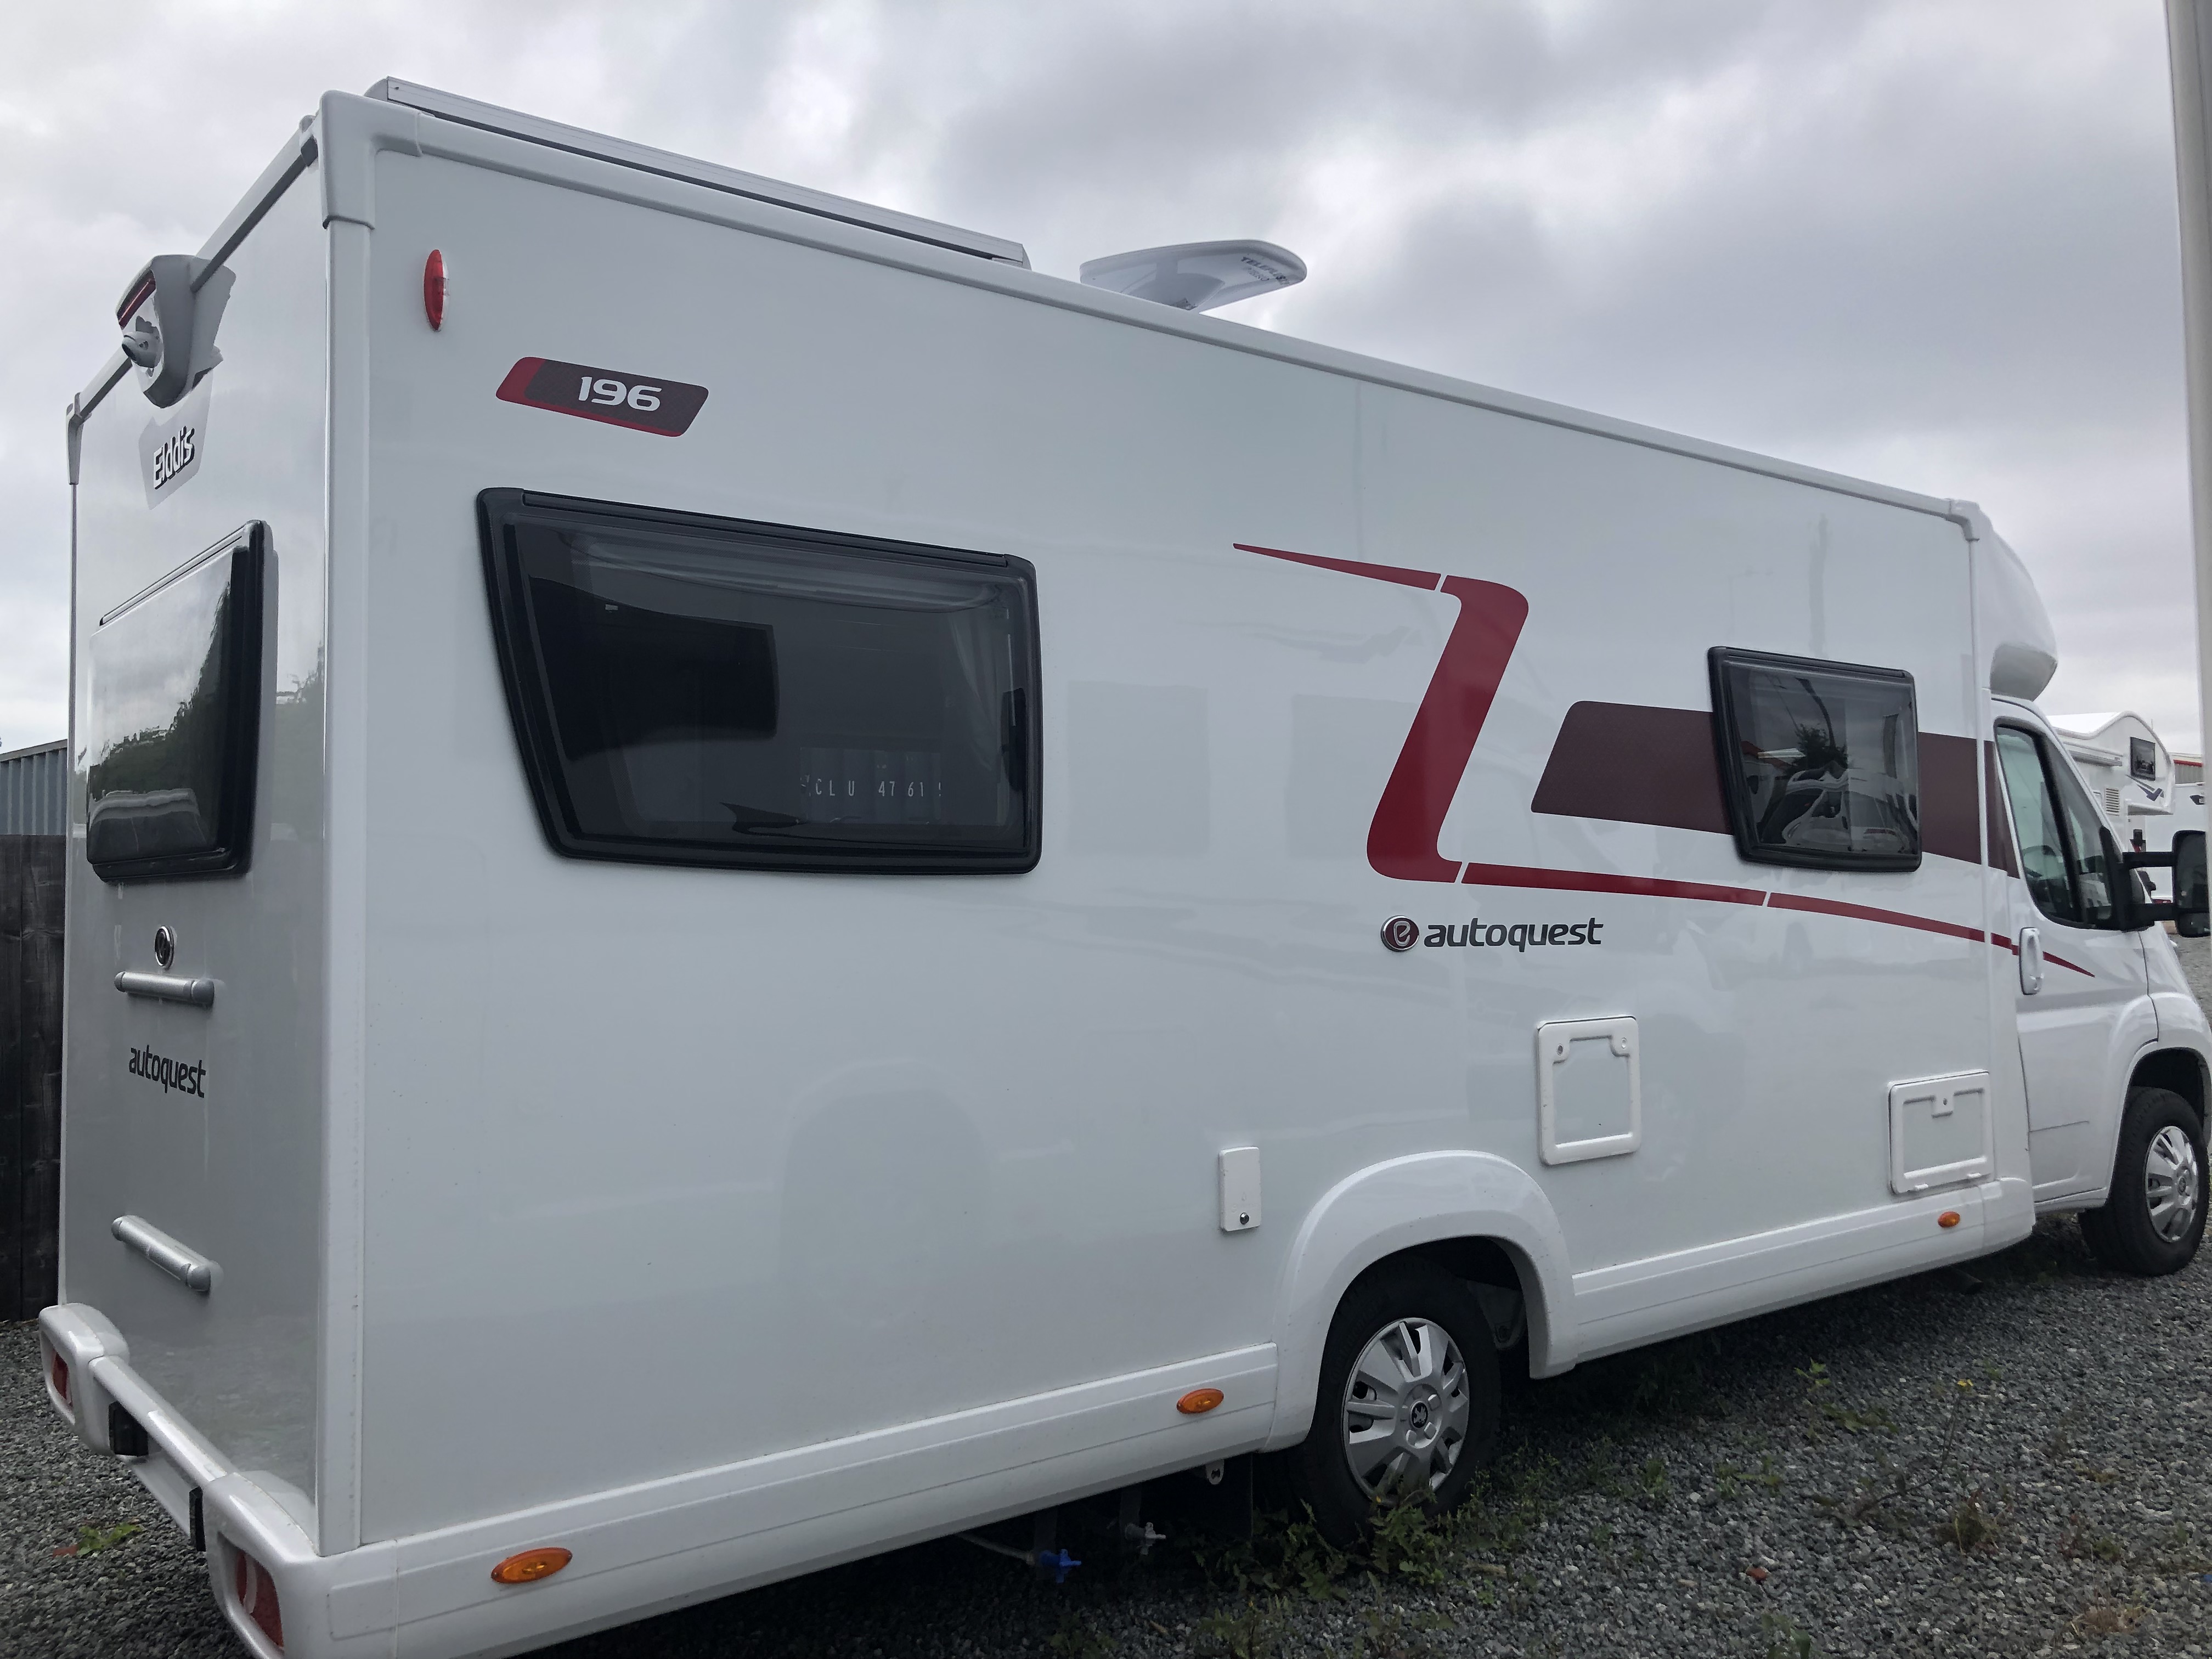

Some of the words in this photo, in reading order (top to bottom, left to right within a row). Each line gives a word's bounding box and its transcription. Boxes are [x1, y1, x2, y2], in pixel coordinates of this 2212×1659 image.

[578, 376, 662, 412] 196
[153, 425, 195, 490] Elddis
[1424, 917, 1604, 953] autoquest
[128, 1044, 207, 1098] autoquest
